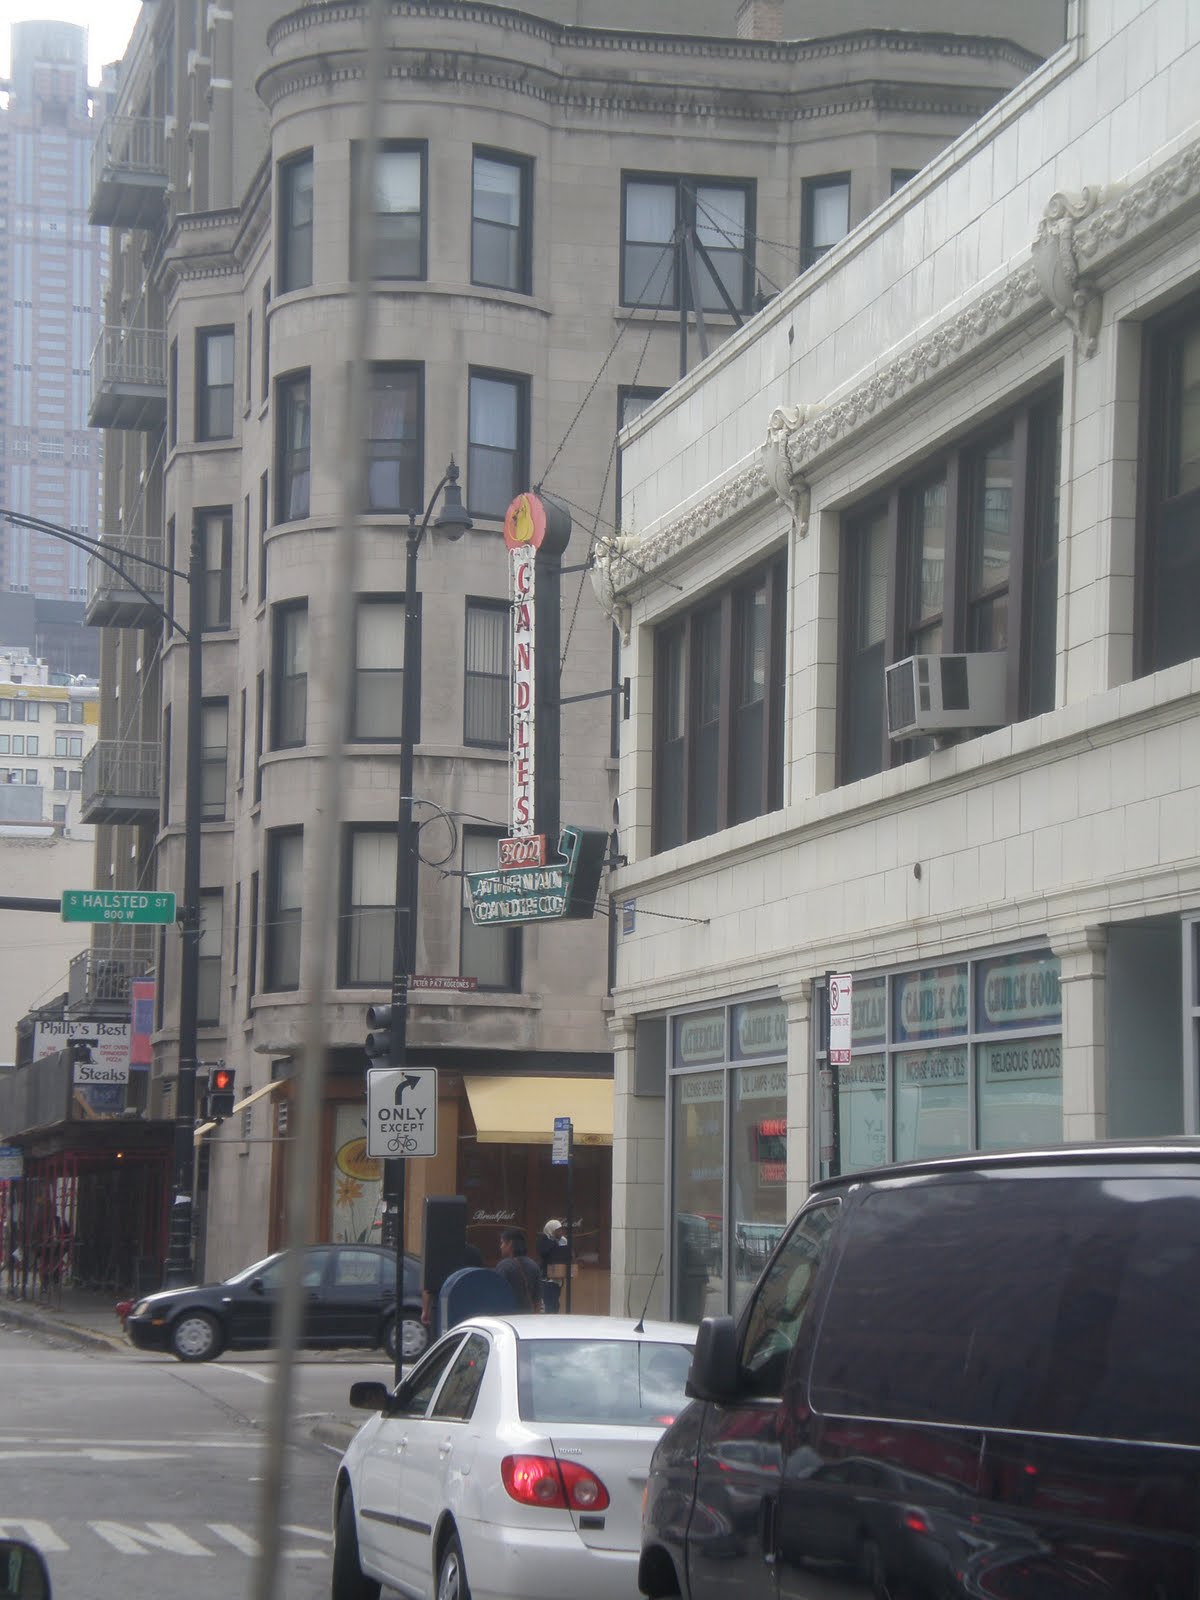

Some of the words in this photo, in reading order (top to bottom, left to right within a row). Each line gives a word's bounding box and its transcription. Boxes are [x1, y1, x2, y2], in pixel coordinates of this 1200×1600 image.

[516, 562, 531, 825] CANDLES
[70, 896, 77, 905] S
[82, 894, 149, 908] HALSTED
[154, 898, 168, 907] ST
[475, 896, 538, 920] CANDLE
[103, 910, 124, 919] 800
[126, 911, 135, 919] W
[905, 987, 946, 1022] CANDLE
[988, 974, 1027, 1012] CHURCH
[1029, 968, 1062, 1008] GOOD
[40, 1021, 89, 1037] Philly's
[96, 1023, 127, 1036] Best
[991, 1050, 1029, 1074] RELIGIOUS
[1031, 1047, 1061, 1071] GOODS
[80, 1067, 126, 1081] Steaks
[378, 1107, 427, 1120] ONLY
[381, 1122, 424, 1132] EXCEPT
[473, 1210, 516, 1222] Breakfast
[558, 1447, 582, 1455] TOYOTA
